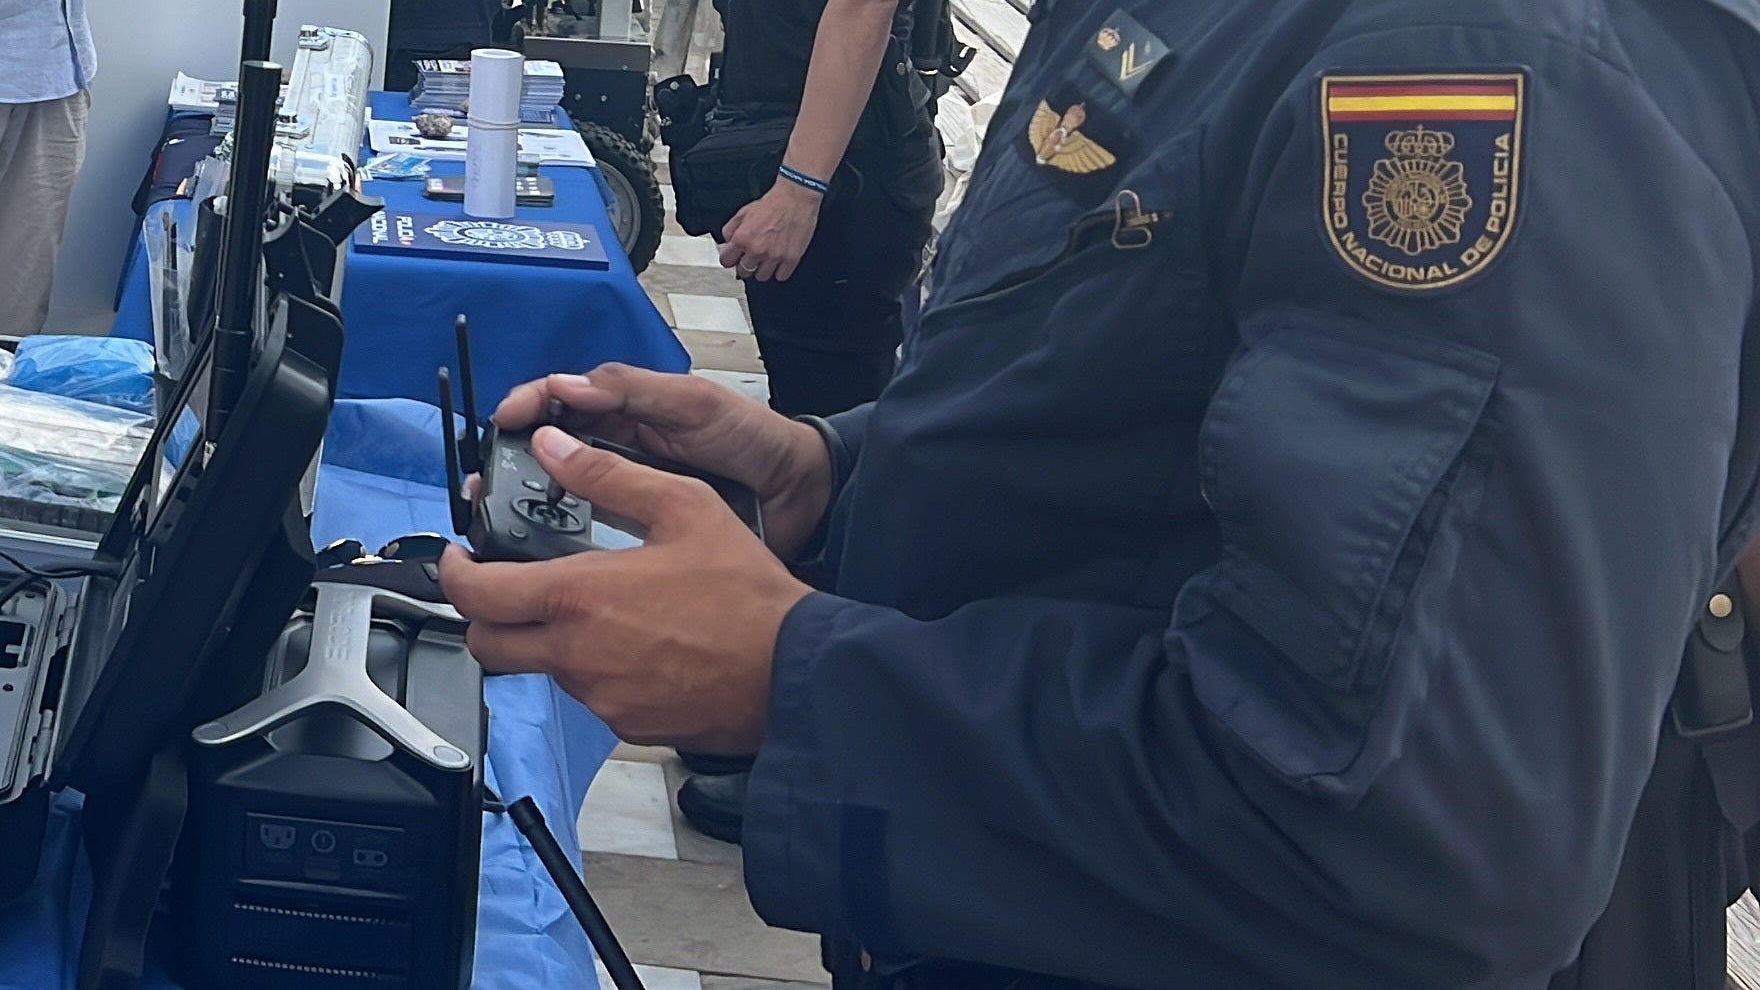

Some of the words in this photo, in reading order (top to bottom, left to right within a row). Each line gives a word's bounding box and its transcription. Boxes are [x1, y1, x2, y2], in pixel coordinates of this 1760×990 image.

[1333, 133, 1349, 229] CUERPO
[1341, 231, 1459, 281] NACIONAL
[1460, 234, 1494, 266] DE
[1485, 132, 1511, 233] POLICIA
